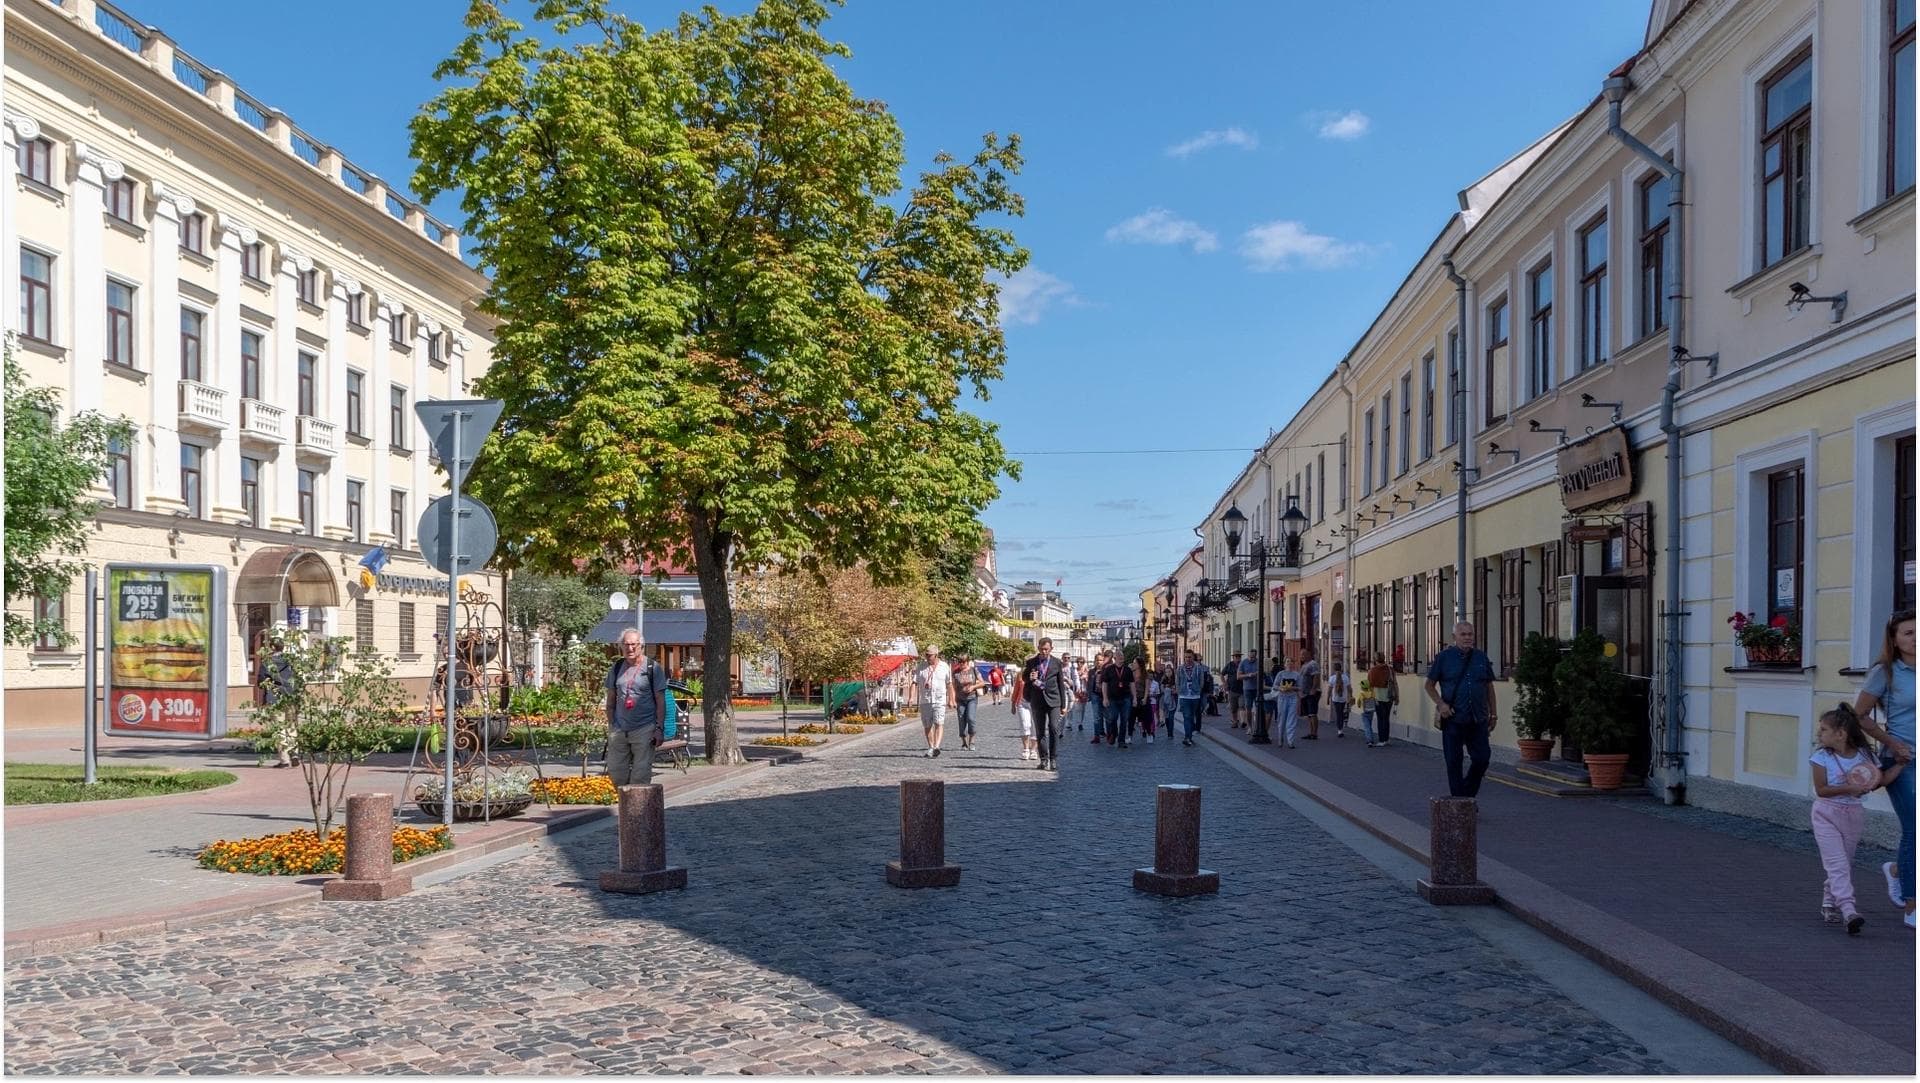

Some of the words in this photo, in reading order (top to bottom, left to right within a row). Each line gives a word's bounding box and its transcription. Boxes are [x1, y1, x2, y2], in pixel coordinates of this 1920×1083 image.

[122, 584, 153, 595] ЛЮБОЙ
[153, 586, 164, 596] ЗА
[123, 704, 142, 716] KING
[164, 698, 194, 716] 300
